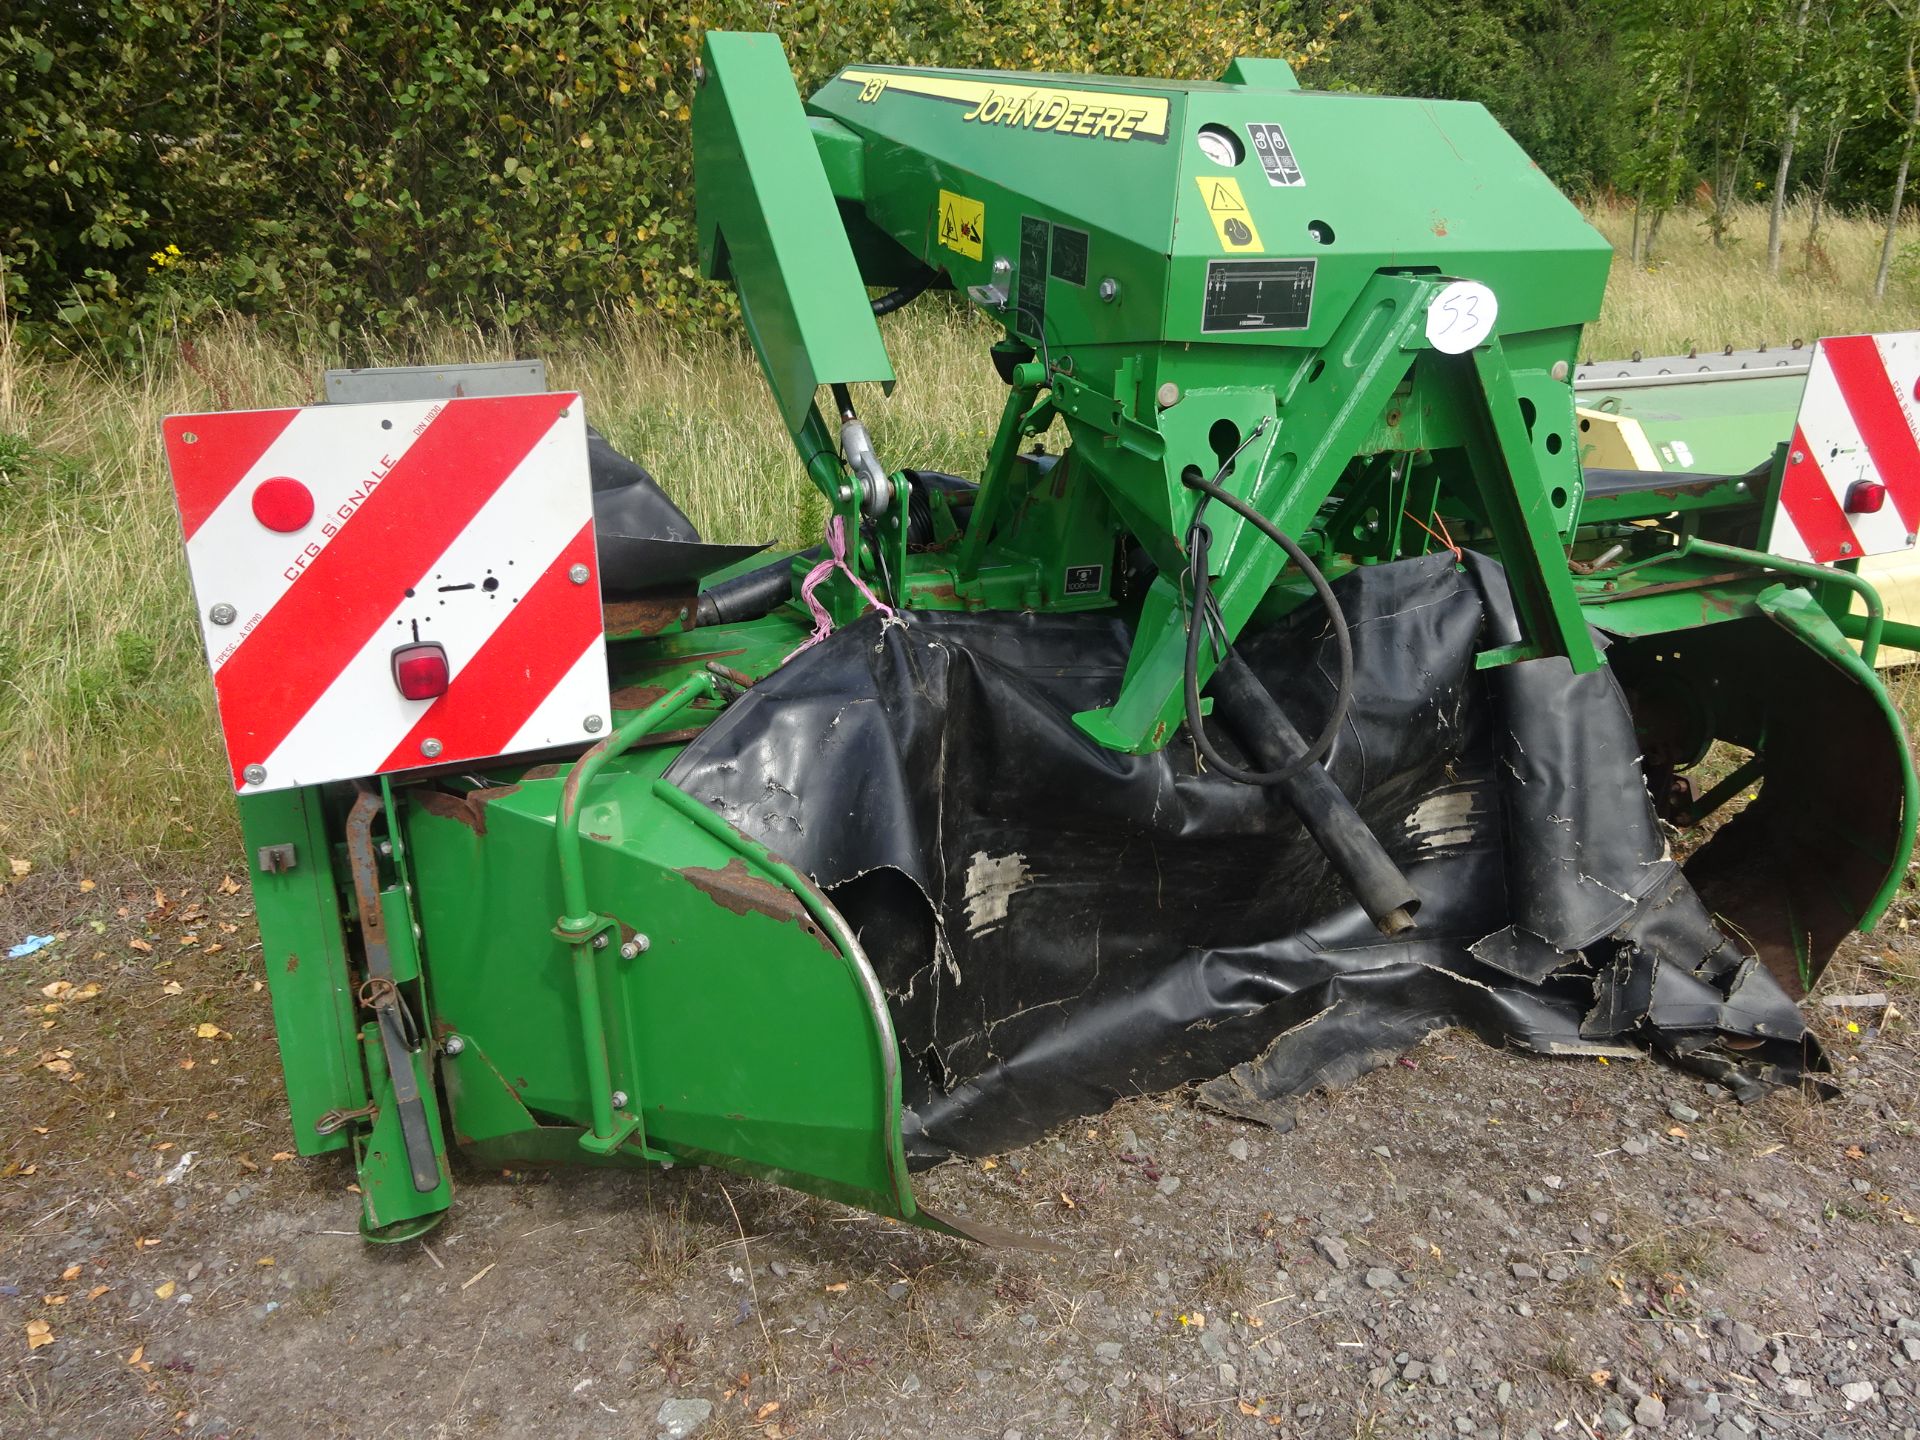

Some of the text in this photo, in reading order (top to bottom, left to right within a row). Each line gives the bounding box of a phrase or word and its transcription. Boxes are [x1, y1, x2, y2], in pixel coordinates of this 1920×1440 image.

[857, 78, 888, 103] 131
[963, 88, 1147, 140] JOHN DEERE
[412, 404, 441, 436] DIN 11030
[283, 542, 321, 582] CFG
[215, 642, 237, 665] TPESC
